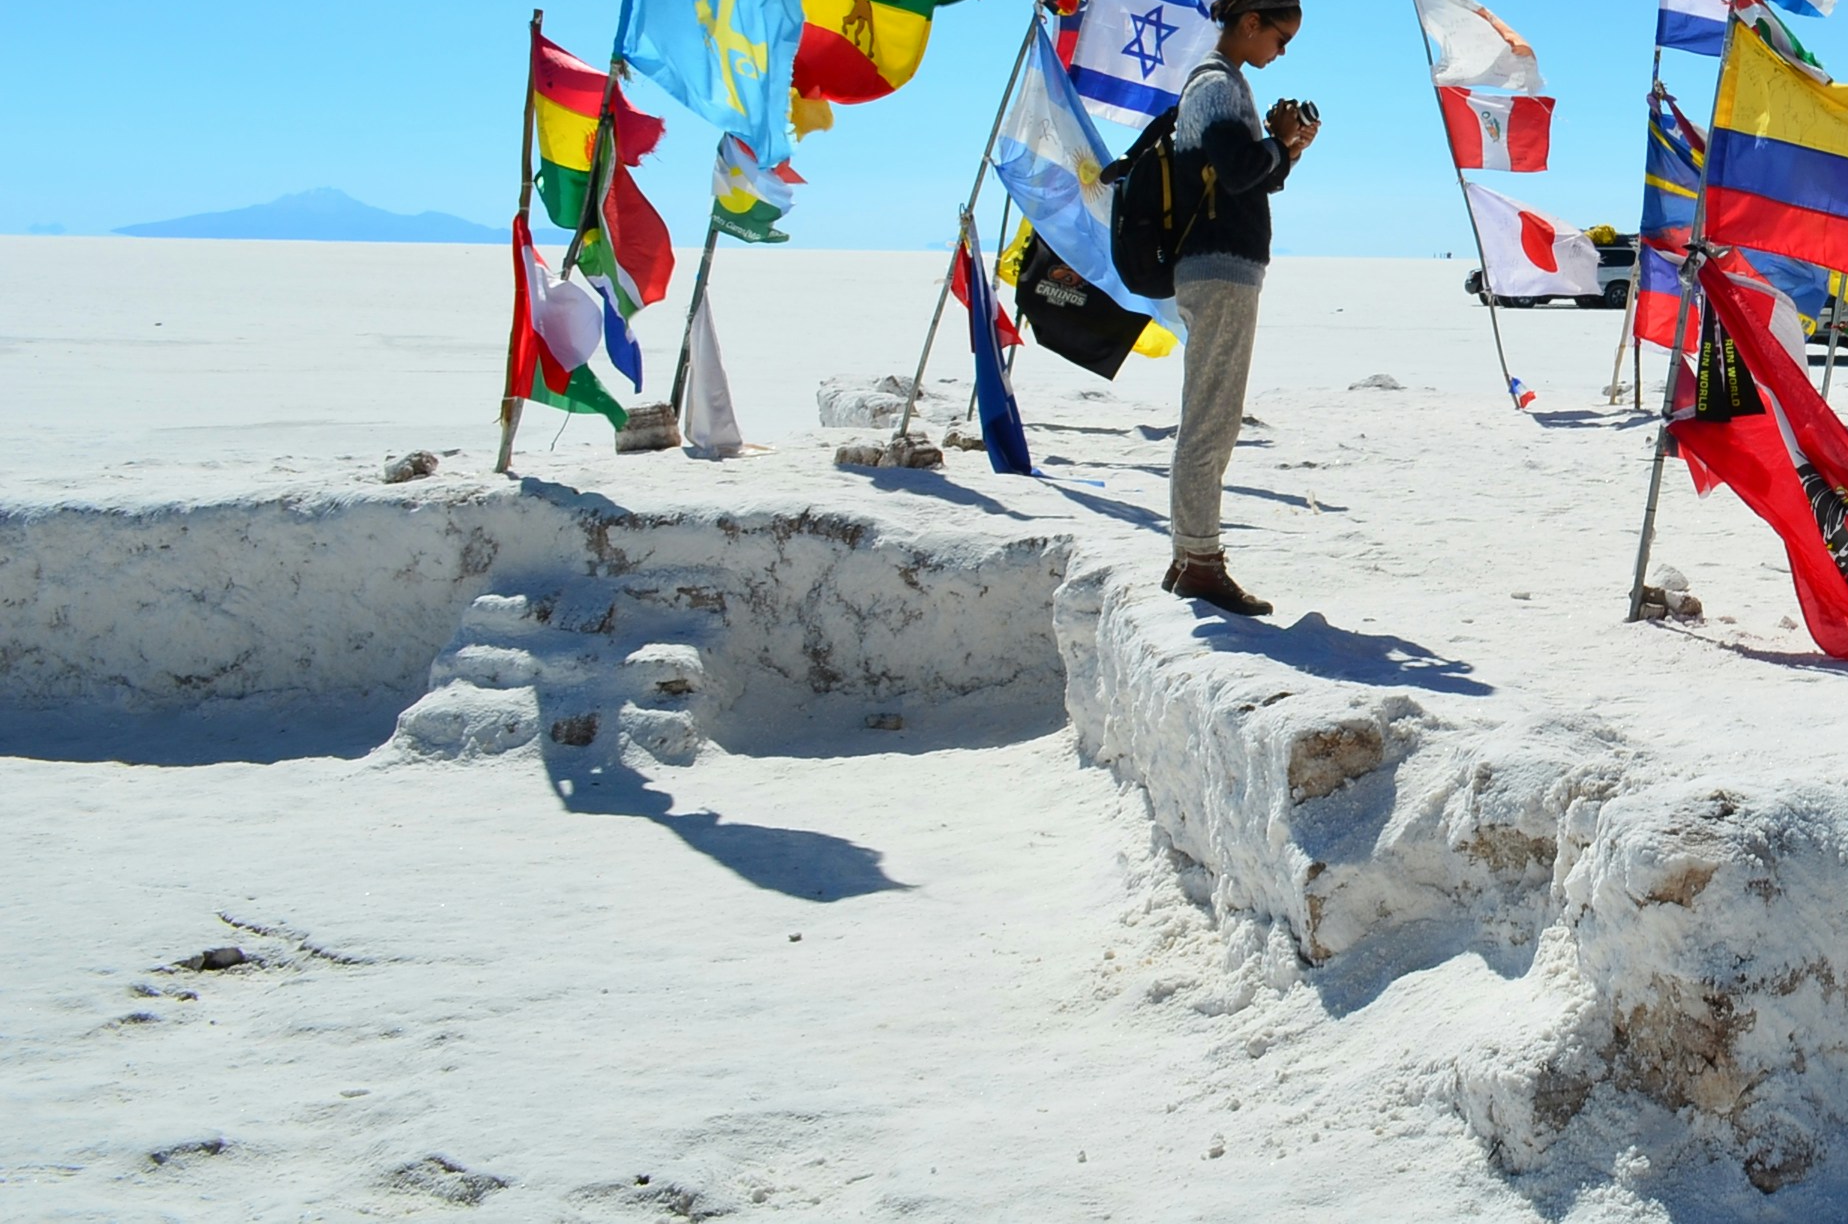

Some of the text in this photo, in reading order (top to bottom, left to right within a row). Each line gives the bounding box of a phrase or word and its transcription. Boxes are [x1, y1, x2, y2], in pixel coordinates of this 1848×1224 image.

[1035, 283, 1086, 307] CANINOS
[1698, 341, 1711, 411] RUN WORLD
[1725, 339, 1741, 407] RUN WORLD
